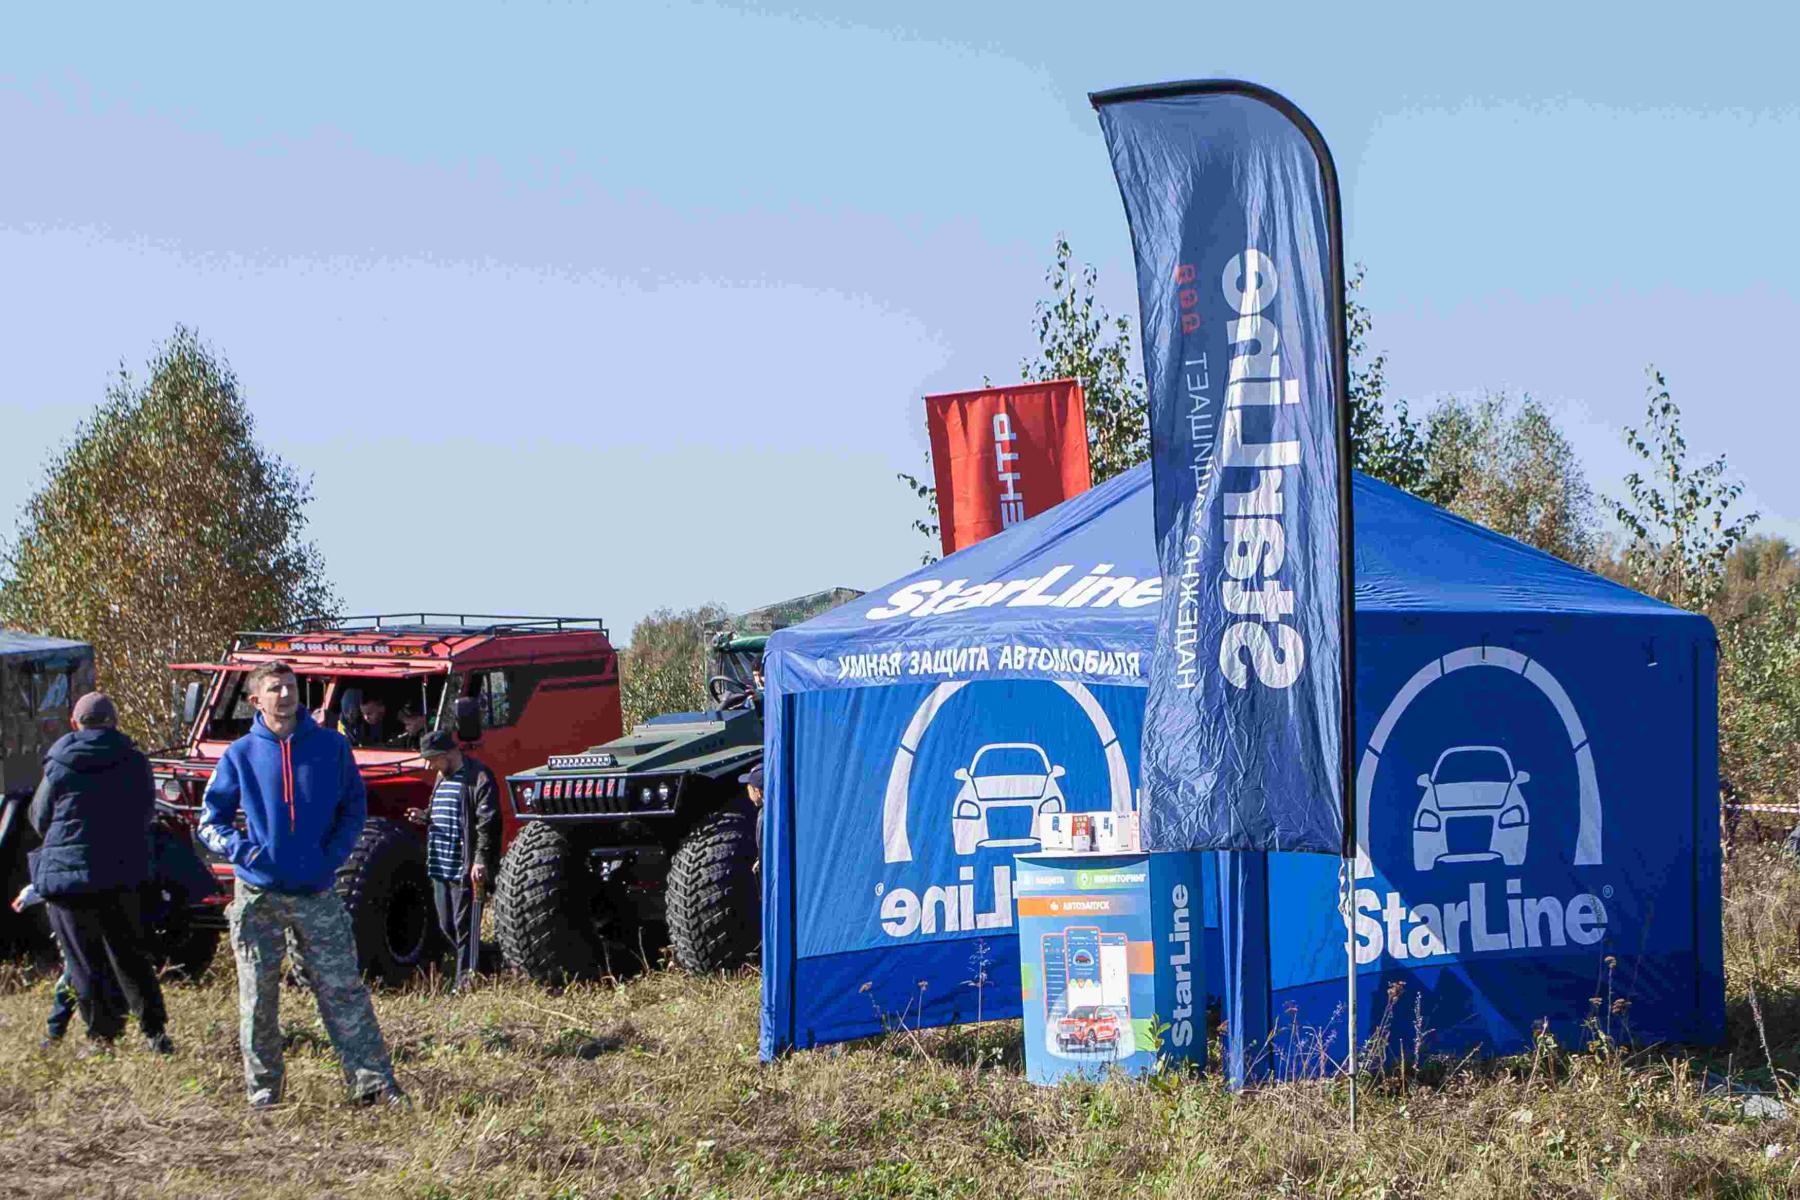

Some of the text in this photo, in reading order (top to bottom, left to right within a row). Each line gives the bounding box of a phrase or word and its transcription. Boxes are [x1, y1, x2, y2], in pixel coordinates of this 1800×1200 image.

[992, 412, 1025, 530] ЕНТР
[865, 563, 1162, 620] StarLine
[837, 645, 1140, 680] УМНАЯ ЗАЩИТА АВТОМОБИЛЯ
[543, 779, 616, 797] GRIZZLY
[1169, 884, 1193, 1047] StarLine
